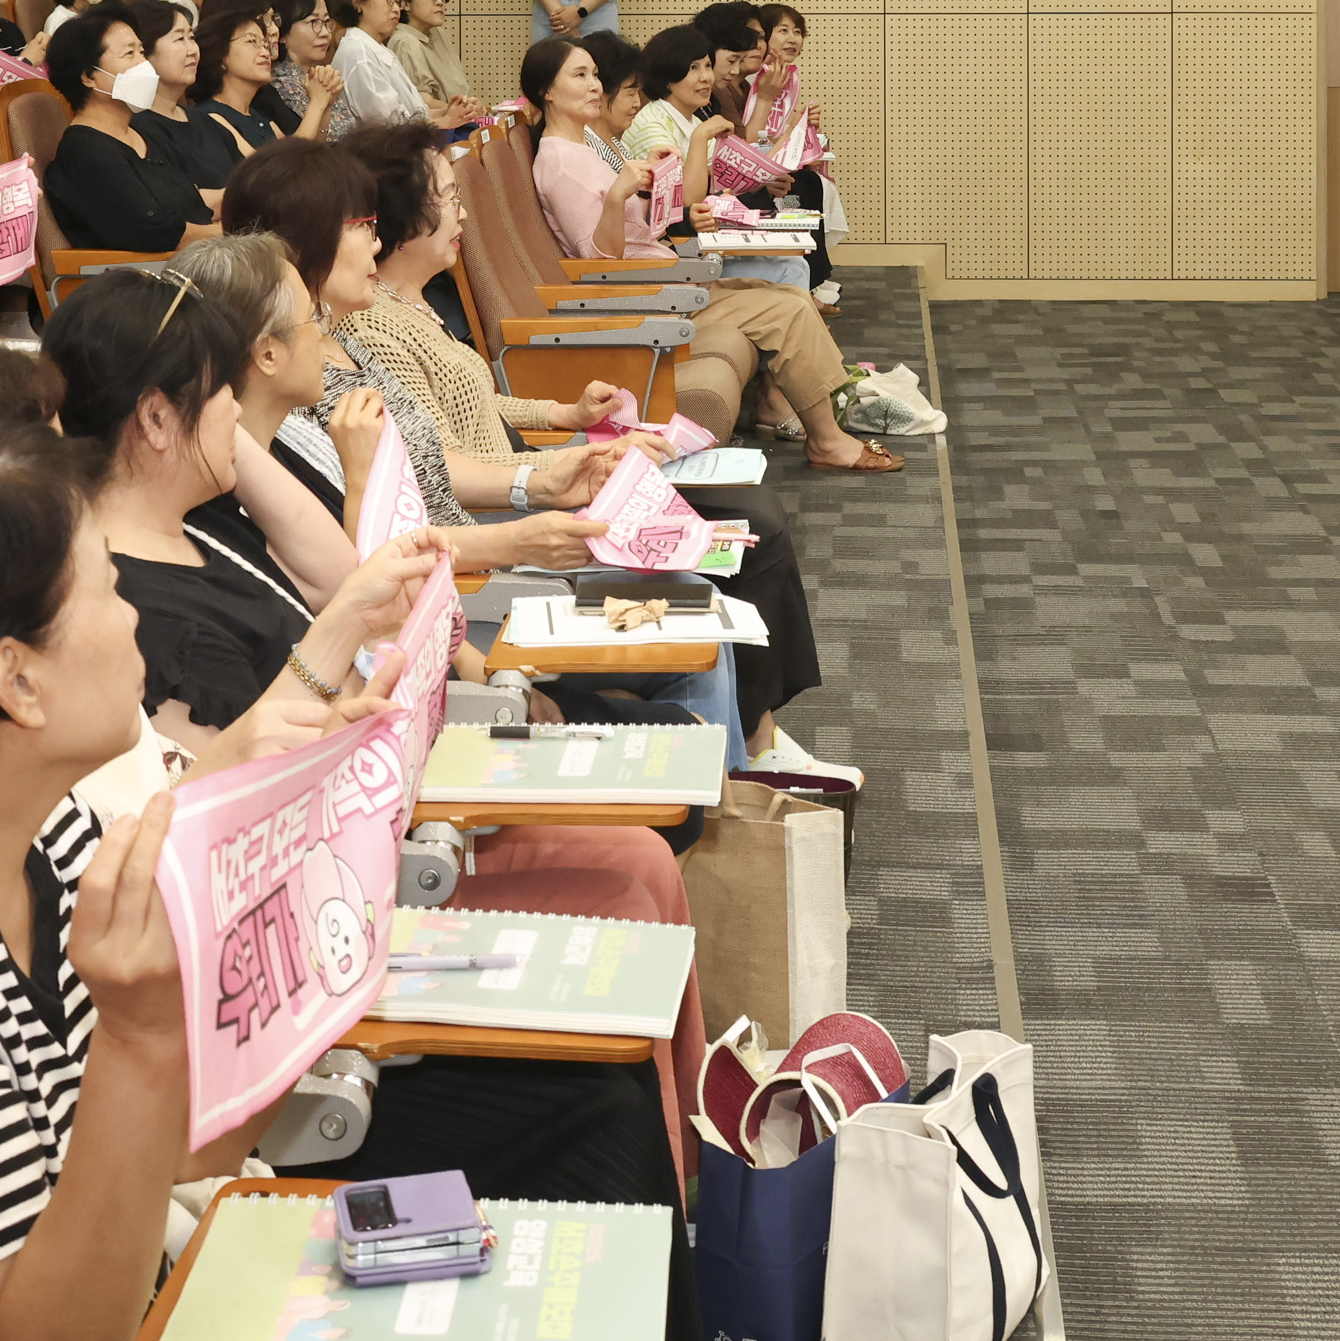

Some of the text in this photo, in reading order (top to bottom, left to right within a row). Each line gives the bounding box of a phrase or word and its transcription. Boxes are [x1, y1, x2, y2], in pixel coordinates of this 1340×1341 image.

[717, 145, 759, 177] 서초구
[2, 180, 34, 217] 행복
[210, 738, 404, 938] 서초구 모든 가족의
[217, 882, 307, 1048] 우리가
[503, 1219, 548, 1287] 양성교육
